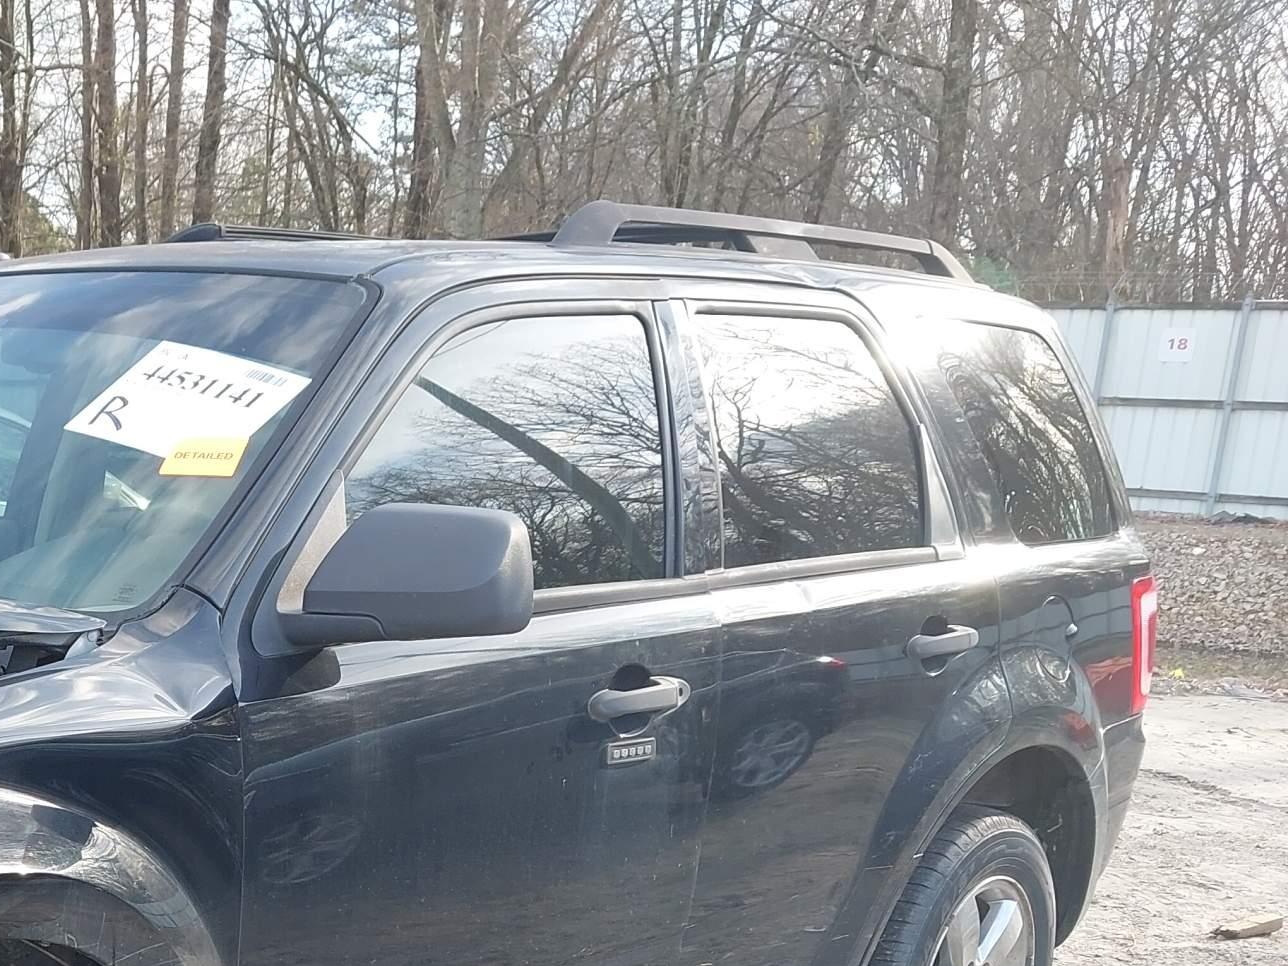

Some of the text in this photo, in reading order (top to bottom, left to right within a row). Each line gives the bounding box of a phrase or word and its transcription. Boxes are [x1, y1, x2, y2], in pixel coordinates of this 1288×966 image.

[1167, 338, 1189, 350] 18
[143, 365, 265, 408] 44531141
[88, 395, 130, 431] R
[173, 451, 235, 461] DETAILED
